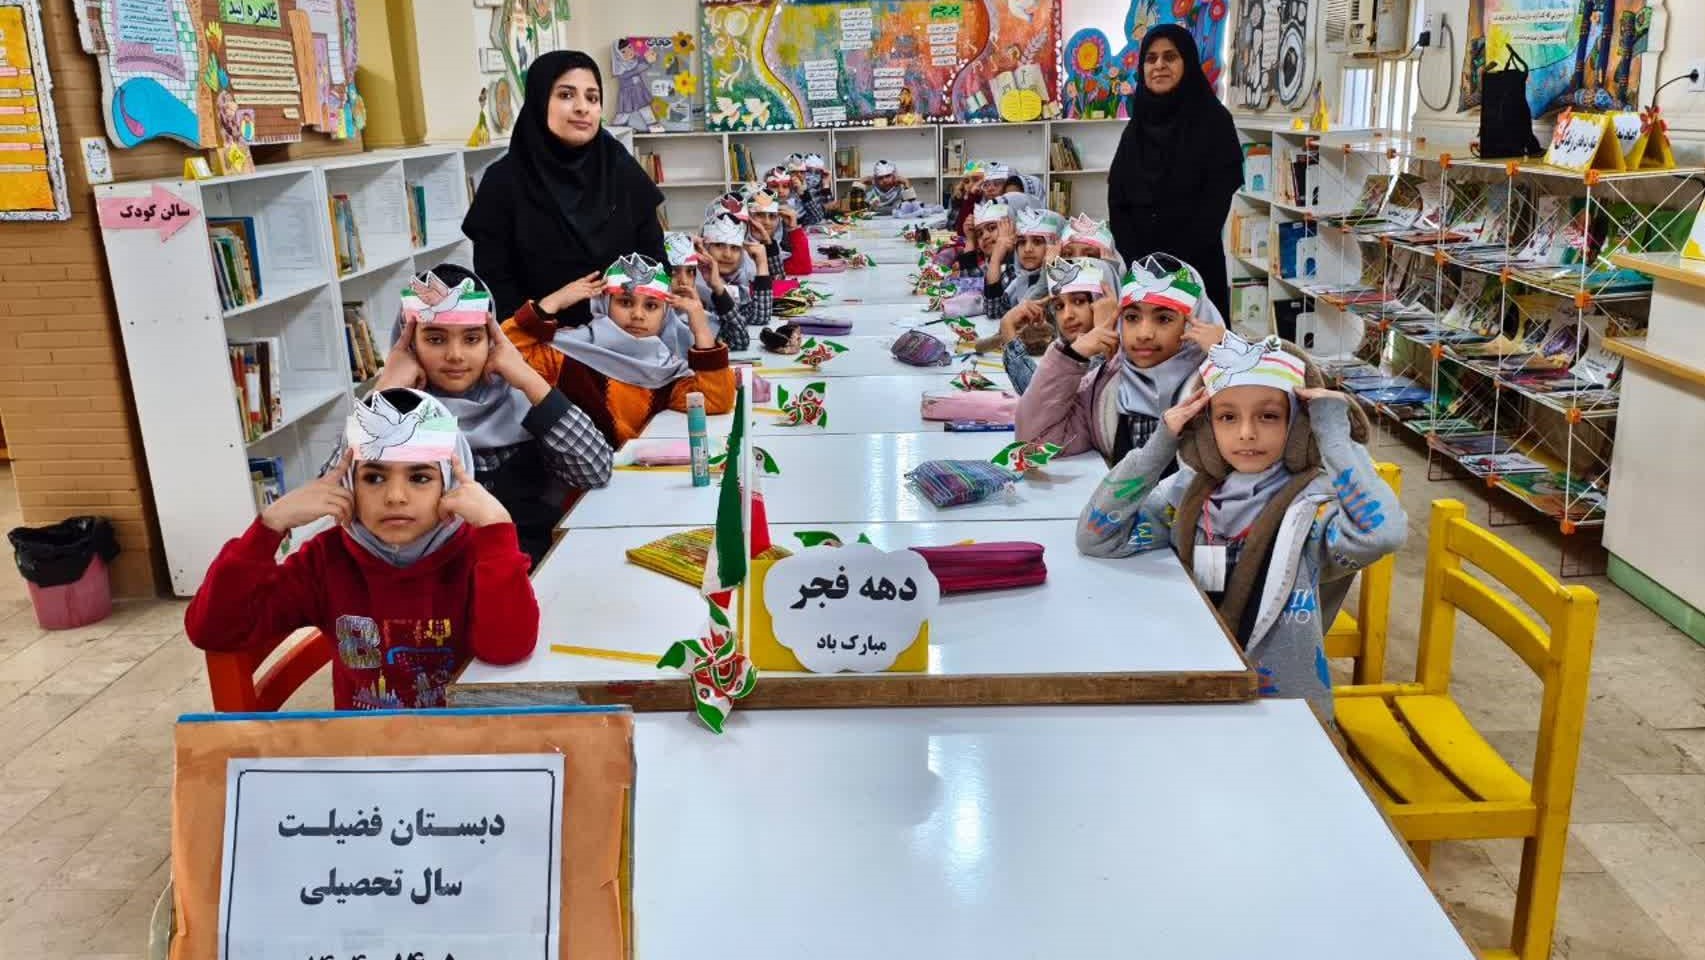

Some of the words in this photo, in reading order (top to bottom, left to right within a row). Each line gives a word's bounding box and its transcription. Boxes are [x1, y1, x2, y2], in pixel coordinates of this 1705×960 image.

[930, 5, 961, 19] پرچم
[119, 204, 157, 222] کودک
[160, 203, 191, 221] سالن
[789, 565, 850, 610] فجر
[858, 573, 918, 602] دهه
[816, 633, 837, 654] باد
[840, 633, 888, 656] مبارک
[277, 805, 384, 846] فضیلت
[389, 807, 507, 846] دبستان
[300, 866, 403, 906] تحصیلی
[409, 868, 464, 906] سال
